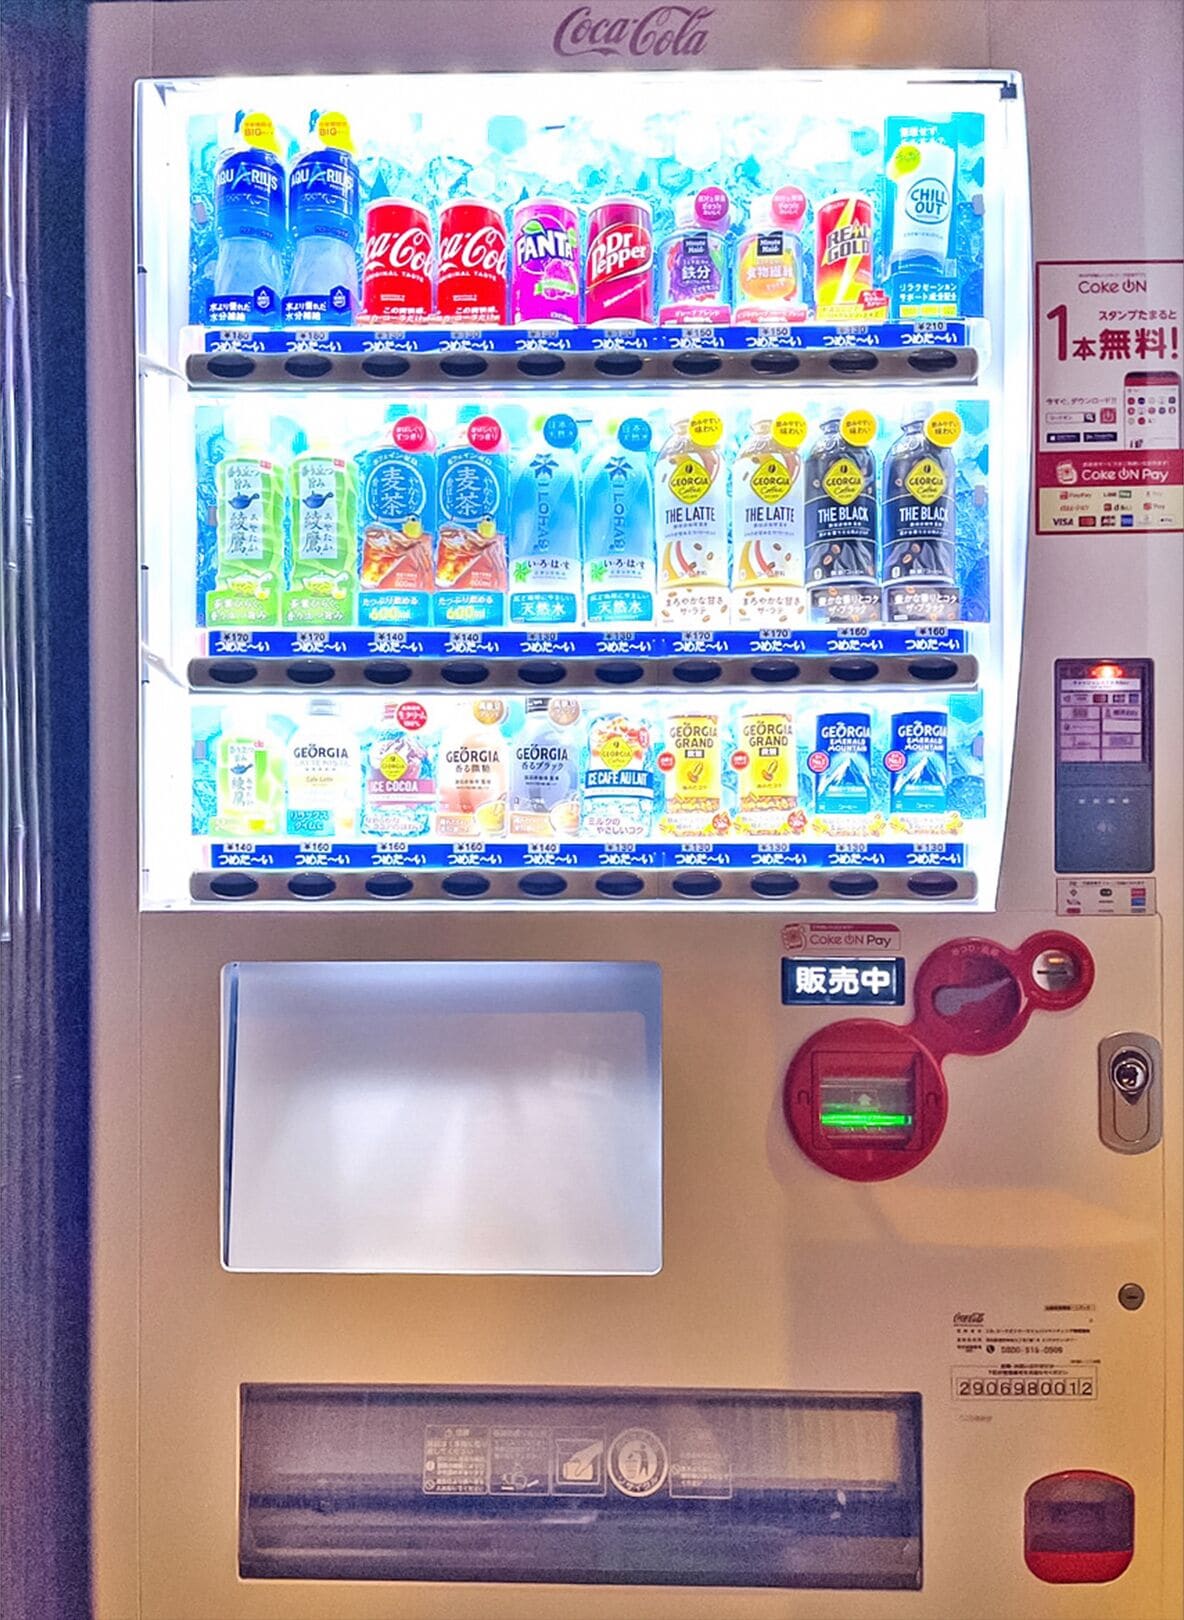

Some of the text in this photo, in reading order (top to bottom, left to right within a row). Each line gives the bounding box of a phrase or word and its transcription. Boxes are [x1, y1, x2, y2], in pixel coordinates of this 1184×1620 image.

[553, 6, 716, 56] Coca-Cola
[910, 188, 947, 206] CHILL
[915, 202, 943, 216] OUT
[606, 231, 633, 249] Dr
[827, 240, 870, 264] GOLD
[591, 245, 646, 280] Pepper
[1078, 278, 1147, 294] Coke ON
[1098, 310, 1177, 321] スタンプたまると
[1081, 467, 1169, 483] Coke ON Pay
[381, 467, 406, 516] 麦茶
[455, 466, 481, 516] 麦茶
[665, 506, 715, 524] THE LATTE
[745, 506, 794, 523] THE LATTE
[818, 506, 869, 523] THE BLACK
[900, 507, 919, 522] THE
[1053, 518, 1073, 526] VISA
[763, 630, 788, 638] ¥170
[675, 738, 714, 749] GRAND
[749, 736, 788, 747] GRAND
[386, 781, 419, 792] COCOA
[810, 934, 892, 948] Coke ON Pay
[796, 966, 890, 995] 販売中
[959, 1382, 1092, 1396] 2906980012
